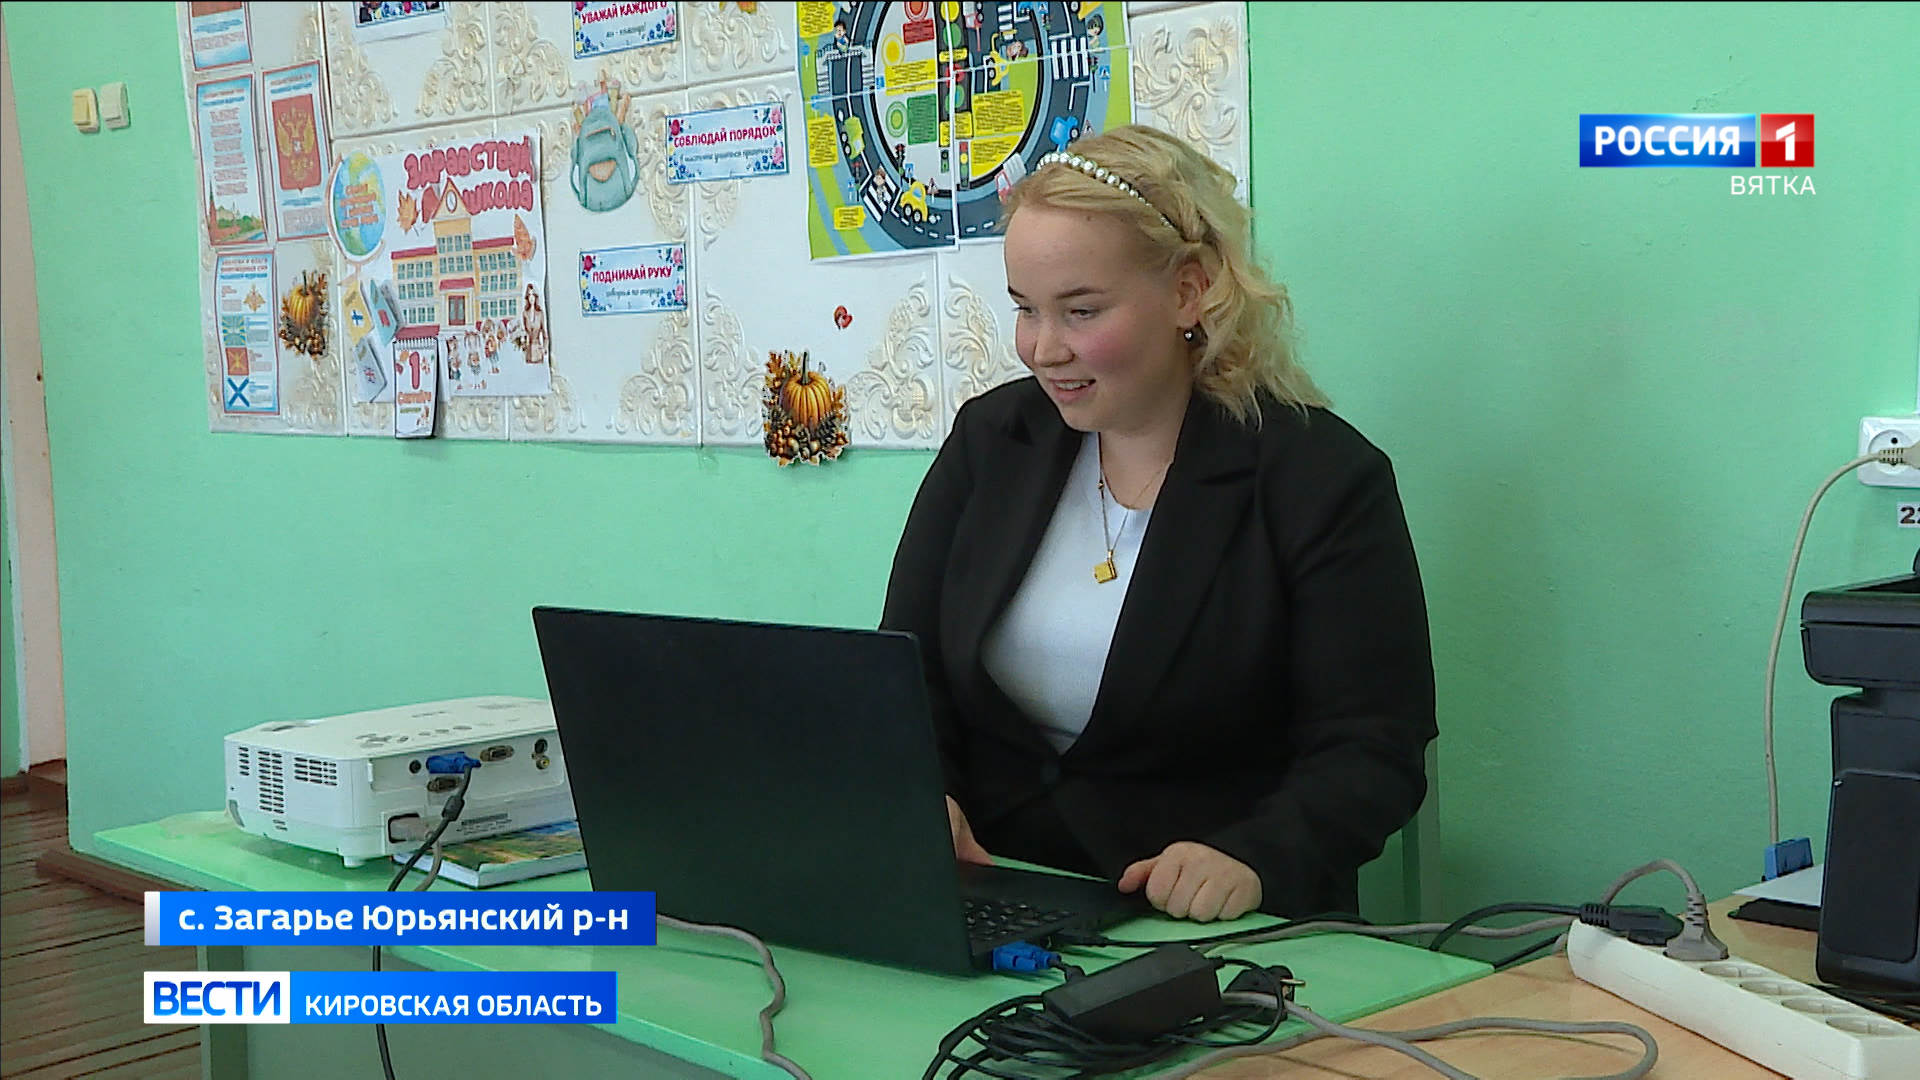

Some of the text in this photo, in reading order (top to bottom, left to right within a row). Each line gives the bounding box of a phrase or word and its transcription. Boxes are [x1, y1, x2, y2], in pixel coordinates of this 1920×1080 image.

[581, 3, 618, 25] УВАЖАЙ
[673, 125, 777, 148] СОБЛЮДАЙ ПОРЯДОК
[462, 179, 534, 216] ШКОЛА
[592, 264, 672, 284] ПОДНИМАЙ РУКУ
[1900, 506, 1920, 524] 2
